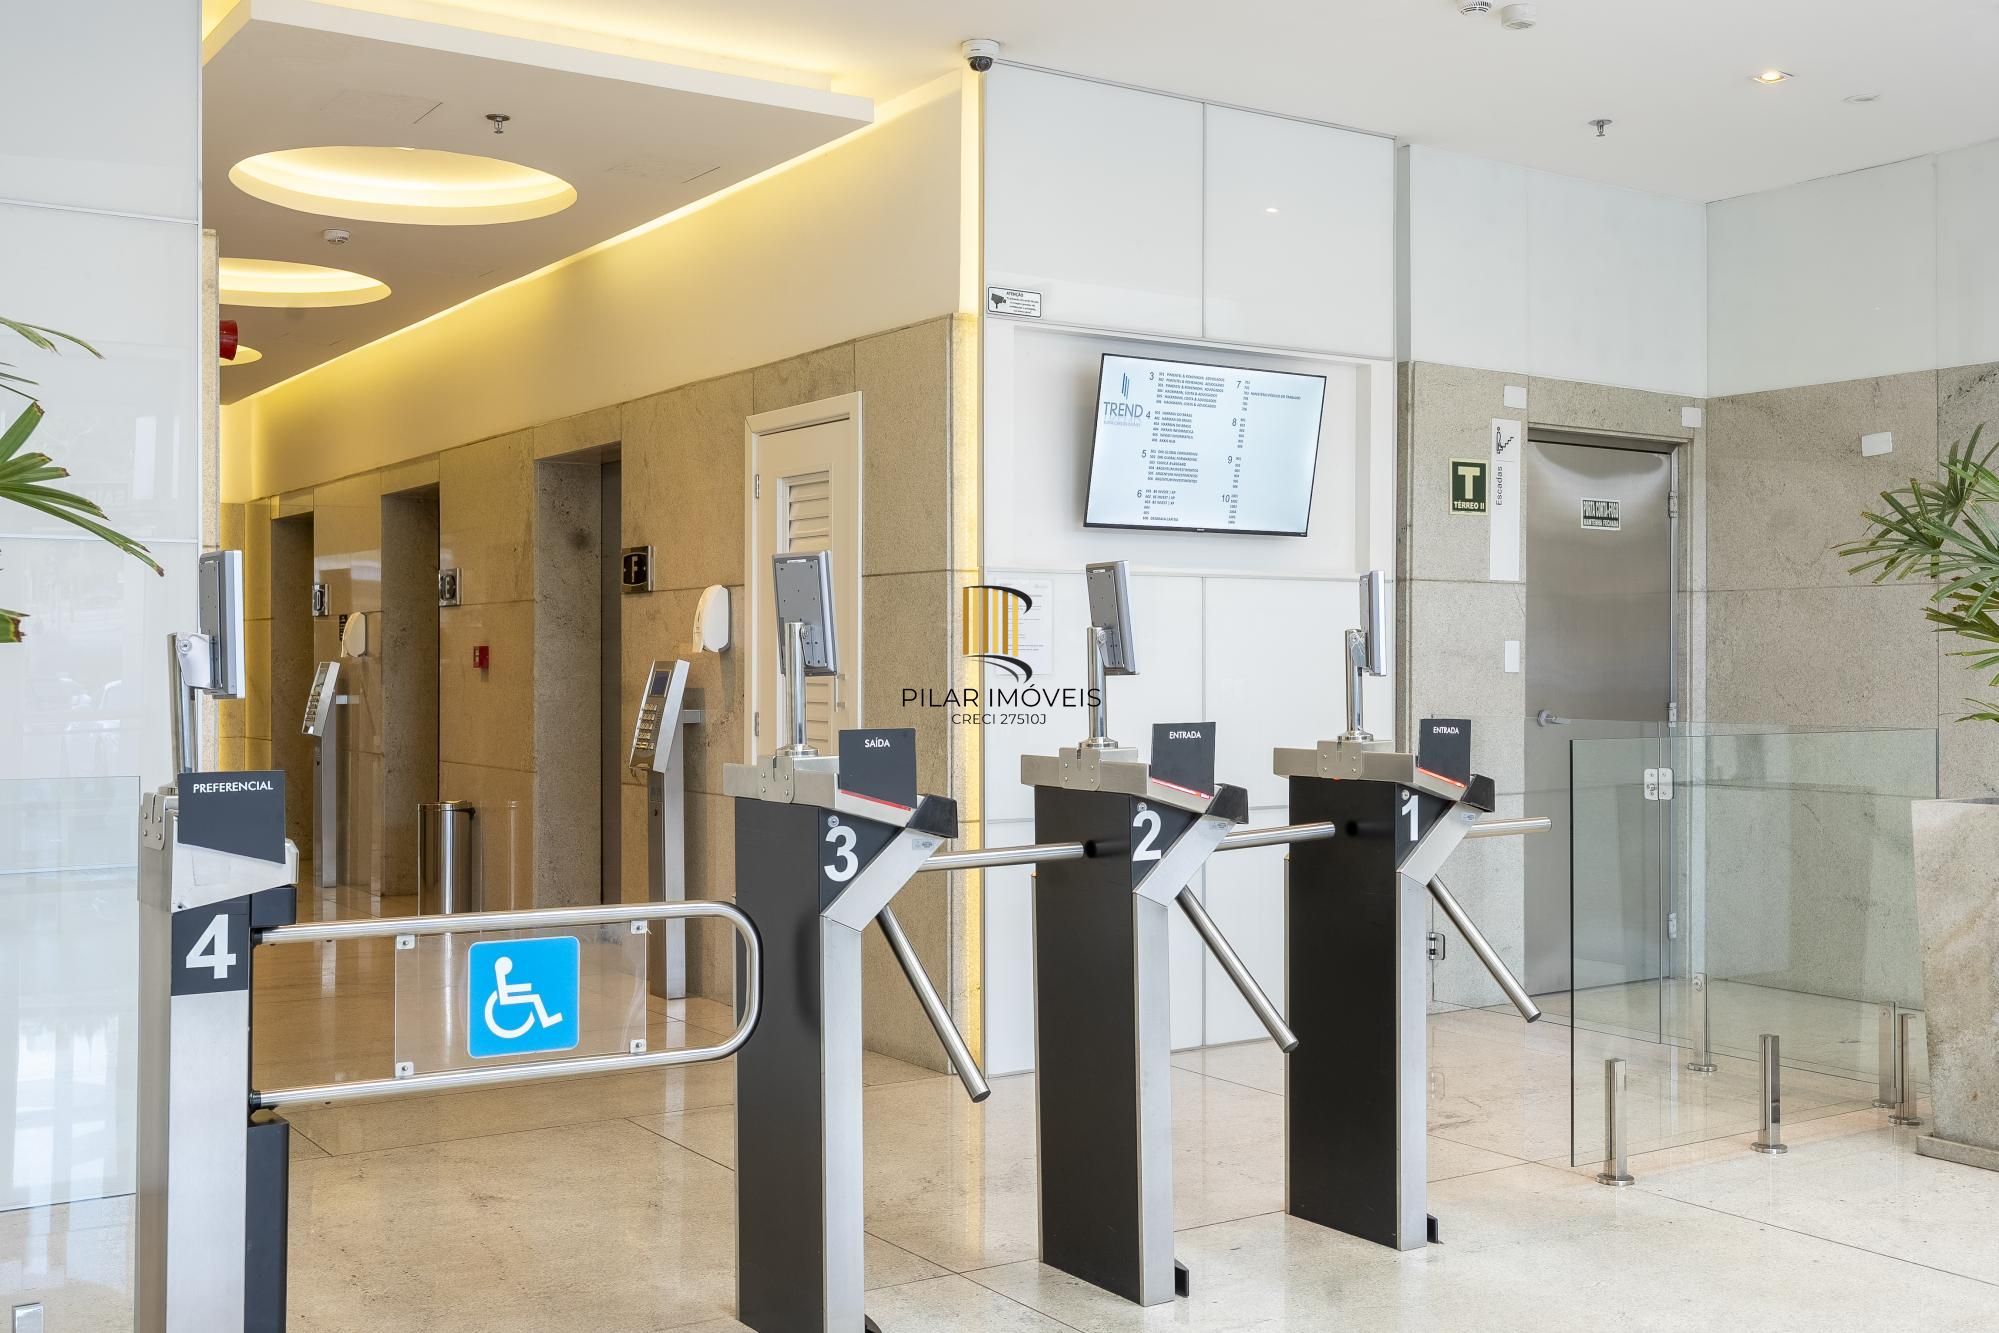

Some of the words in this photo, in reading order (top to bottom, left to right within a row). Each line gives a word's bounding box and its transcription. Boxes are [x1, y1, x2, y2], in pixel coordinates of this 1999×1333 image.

[1149, 372, 1154, 380] 3
[1104, 401, 1144, 418] TREND
[1146, 411, 1151, 419] 4
[1232, 418, 1237, 426] 8
[1142, 450, 1146, 458] 5
[1228, 456, 1232, 464] 9
[1458, 466, 1480, 499] T
[1137, 490, 1142, 498] 6
[1222, 494, 1230, 503] 10
[1454, 500, 1479, 509] TÉRREO
[632, 556, 638, 582] F
[1169, 731, 1201, 739] ENTRADA
[865, 737, 890, 748] SAÍDA
[193, 780, 274, 793] PREFERENCIAL
[1402, 795, 1418, 842] 1
[1133, 810, 1161, 861] 2
[824, 825, 858, 882] 3
[186, 914, 236, 979] 4
